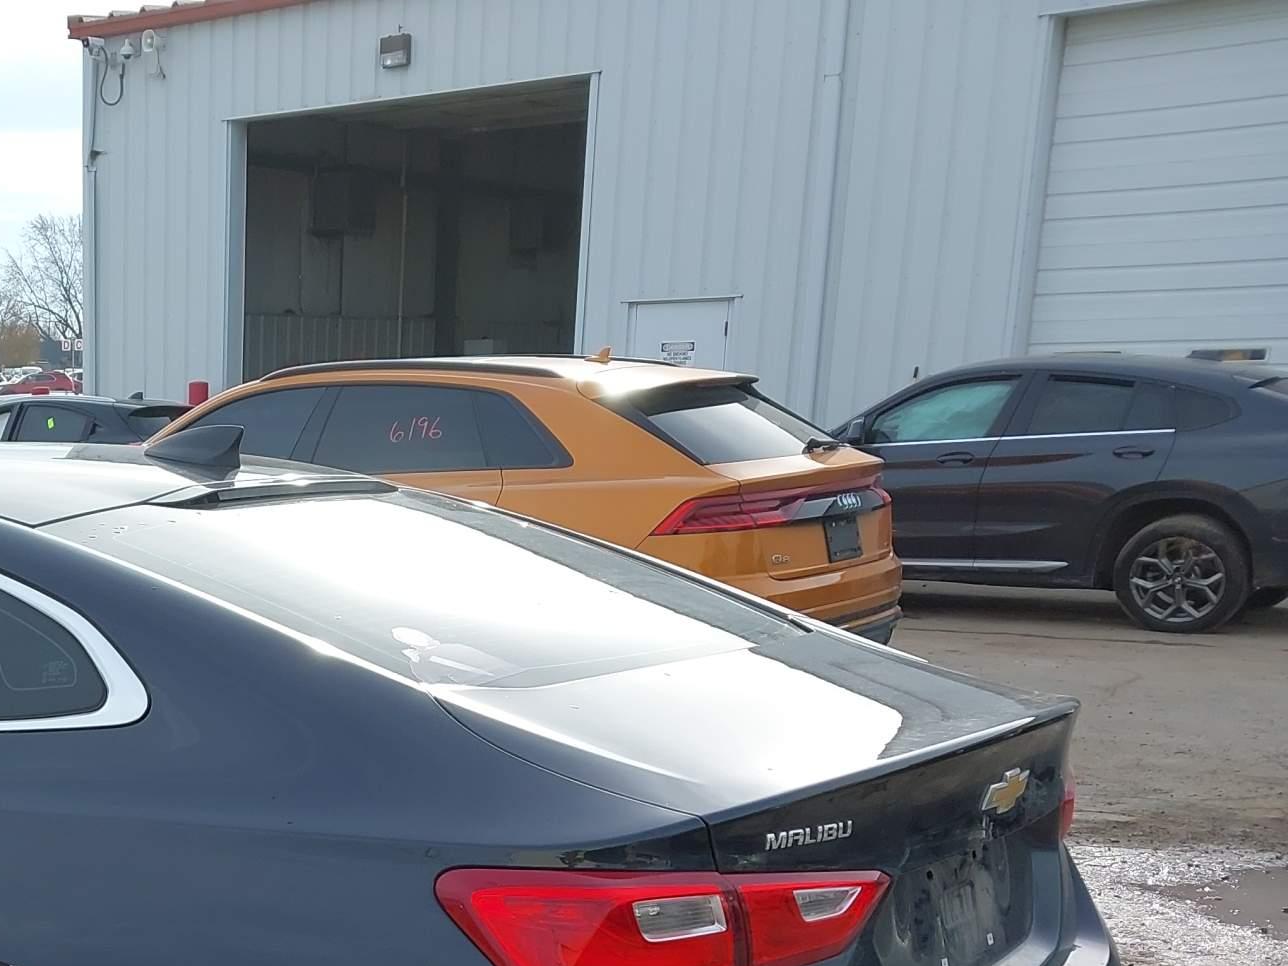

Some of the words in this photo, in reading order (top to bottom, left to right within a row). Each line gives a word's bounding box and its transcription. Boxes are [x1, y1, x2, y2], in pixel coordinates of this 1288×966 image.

[63, 340, 70, 350] D
[75, 340, 83, 350] C
[389, 416, 443, 443] 6196
[765, 820, 853, 851] MALIBU
